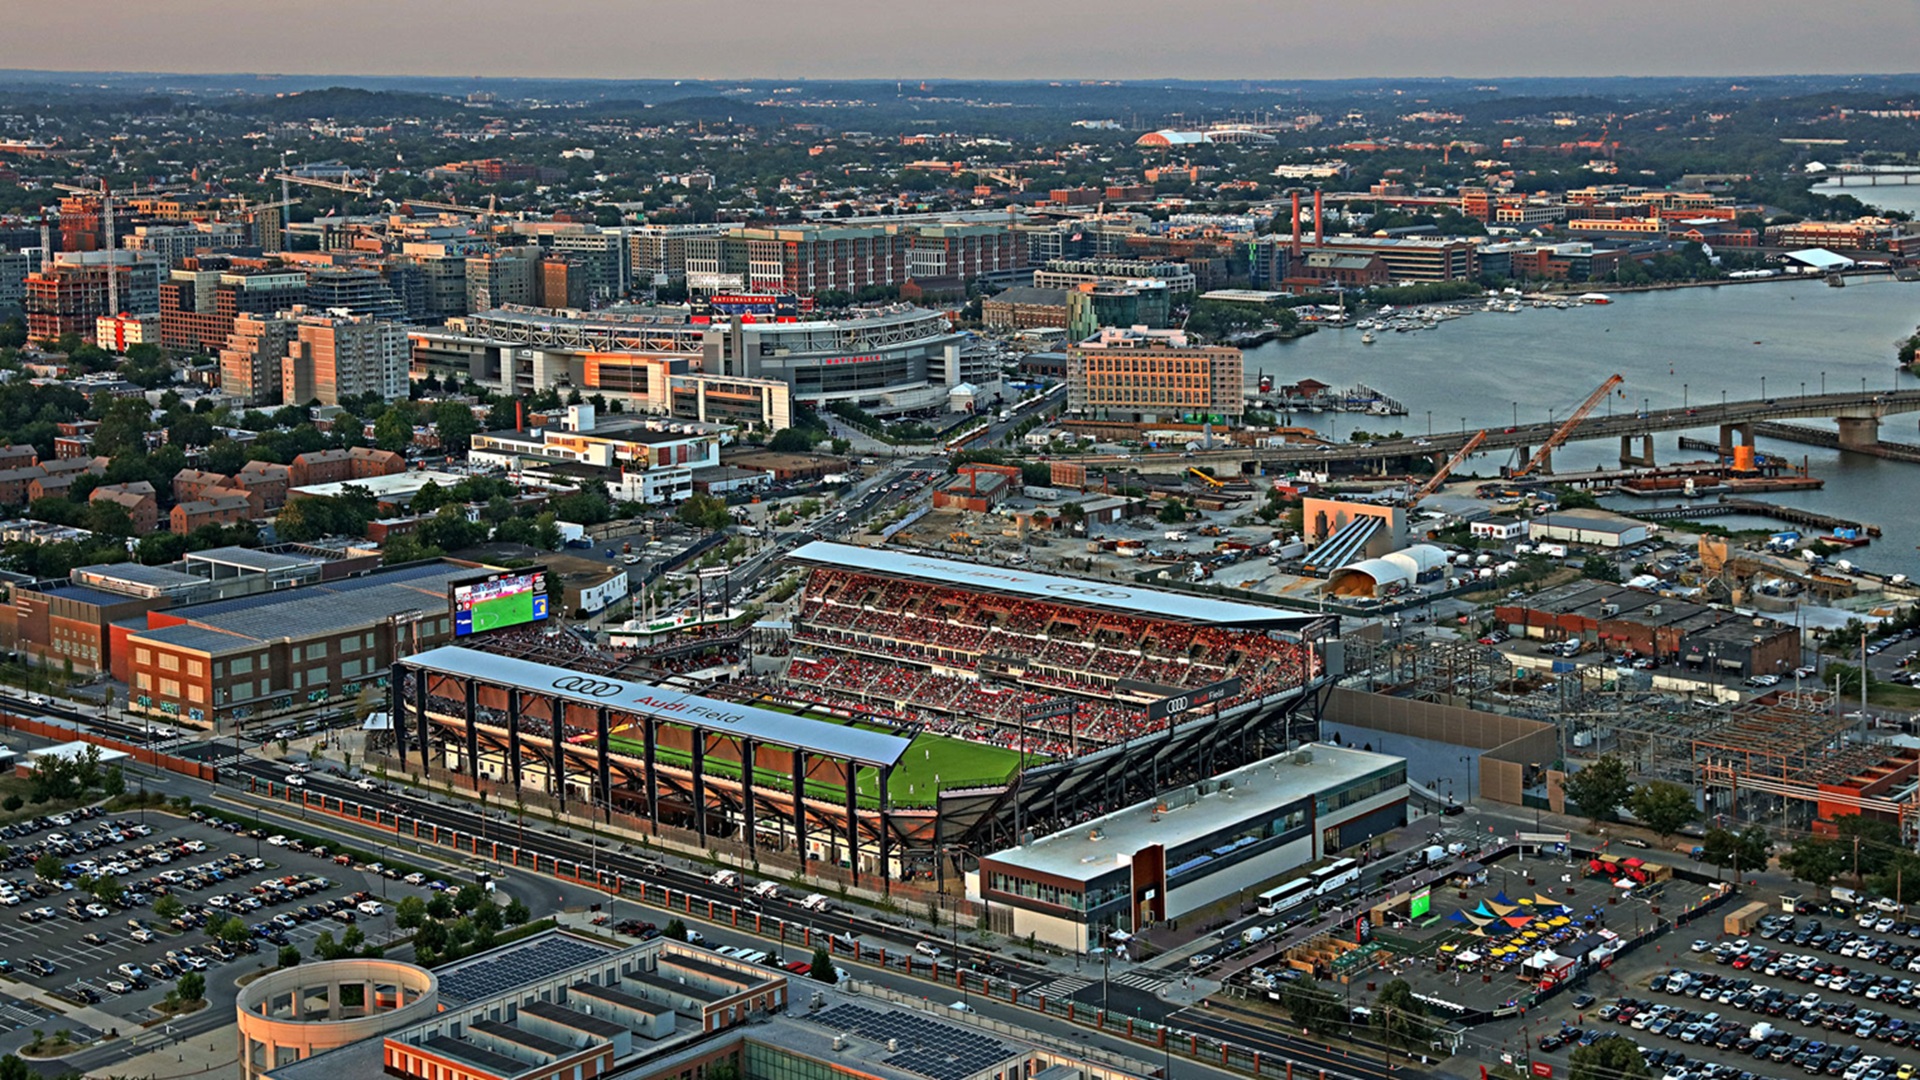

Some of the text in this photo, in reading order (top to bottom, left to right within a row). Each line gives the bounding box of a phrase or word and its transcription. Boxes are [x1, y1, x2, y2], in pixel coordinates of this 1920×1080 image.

[825, 354, 881, 365] NATIONALS
[1209, 689, 1224, 699] Field
[633, 696, 745, 723] Audi Field
